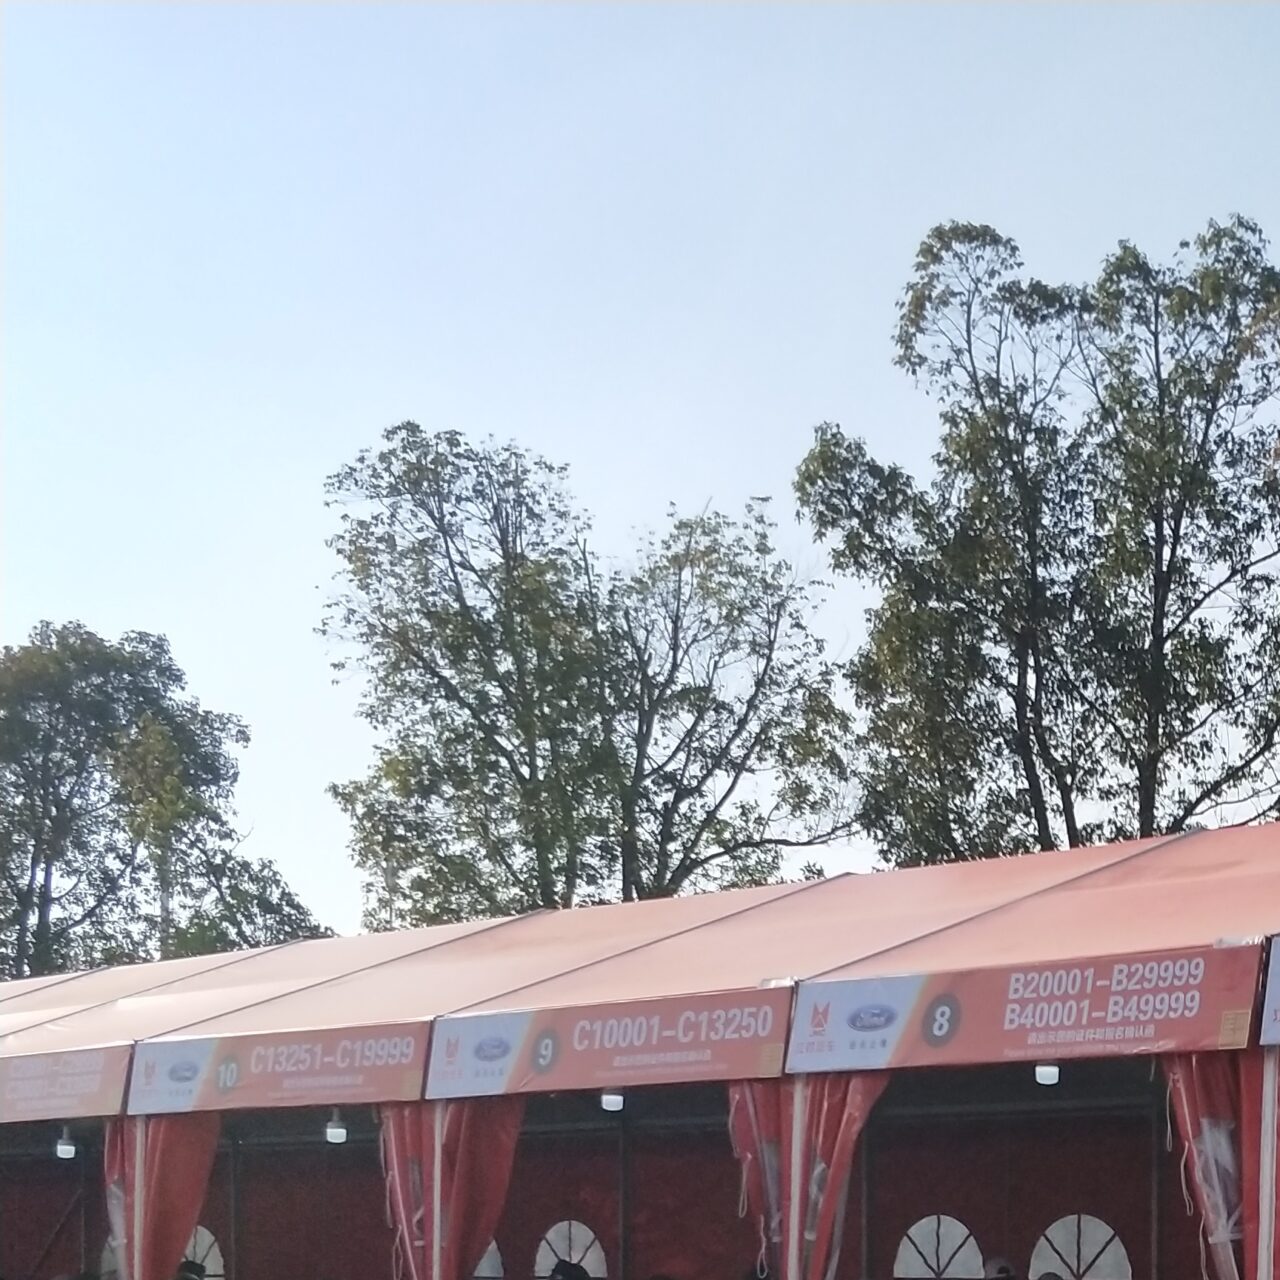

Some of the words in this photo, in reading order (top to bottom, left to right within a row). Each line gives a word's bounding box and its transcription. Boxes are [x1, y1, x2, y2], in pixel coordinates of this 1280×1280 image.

[1008, 957, 1205, 1000] B20001-B29999
[573, 1005, 773, 1051] C10001-C13250
[932, 1004, 950, 1037] 8
[1004, 990, 1201, 1032] B40001-B49999
[250, 1036, 415, 1075] C13251-C19999
[537, 1038, 554, 1067] 9
[218, 1061, 236, 1088] 10
